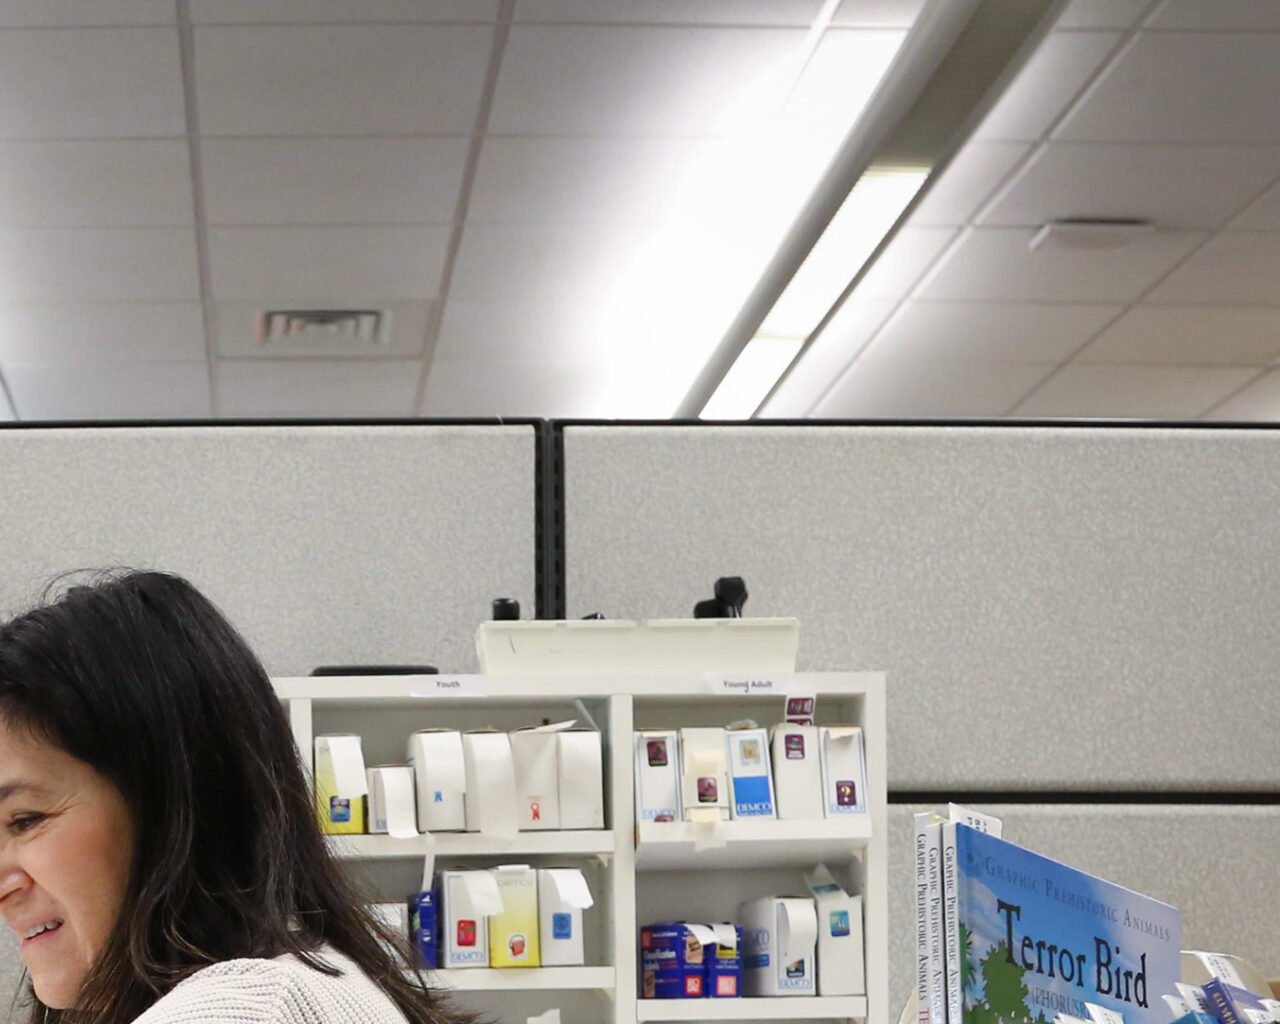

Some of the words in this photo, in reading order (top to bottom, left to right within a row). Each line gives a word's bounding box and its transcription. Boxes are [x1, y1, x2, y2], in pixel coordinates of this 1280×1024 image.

[435, 680, 461, 689] Youth
[723, 680, 750, 692] Young
[751, 680, 773, 689] Adult
[736, 803, 773, 815] DEMCO
[916, 833, 926, 882] GRAPHIC
[929, 847, 939, 895] GRAPHIC
[944, 845, 955, 895] GRAPHIC
[917, 883, 929, 951] PREHISTORIC
[985, 856, 1038, 892] GRAPHIC
[1045, 877, 1118, 923] PREHISTORIC
[1123, 909, 1171, 942] ANIMALS
[930, 896, 941, 965] PREHISTORIC
[946, 896, 957, 962] PREHISTORIC
[997, 898, 1086, 987] Terror
[1093, 936, 1149, 1009] Bird
[450, 951, 485, 962] DEMCO
[918, 954, 929, 1001] ANIMALS
